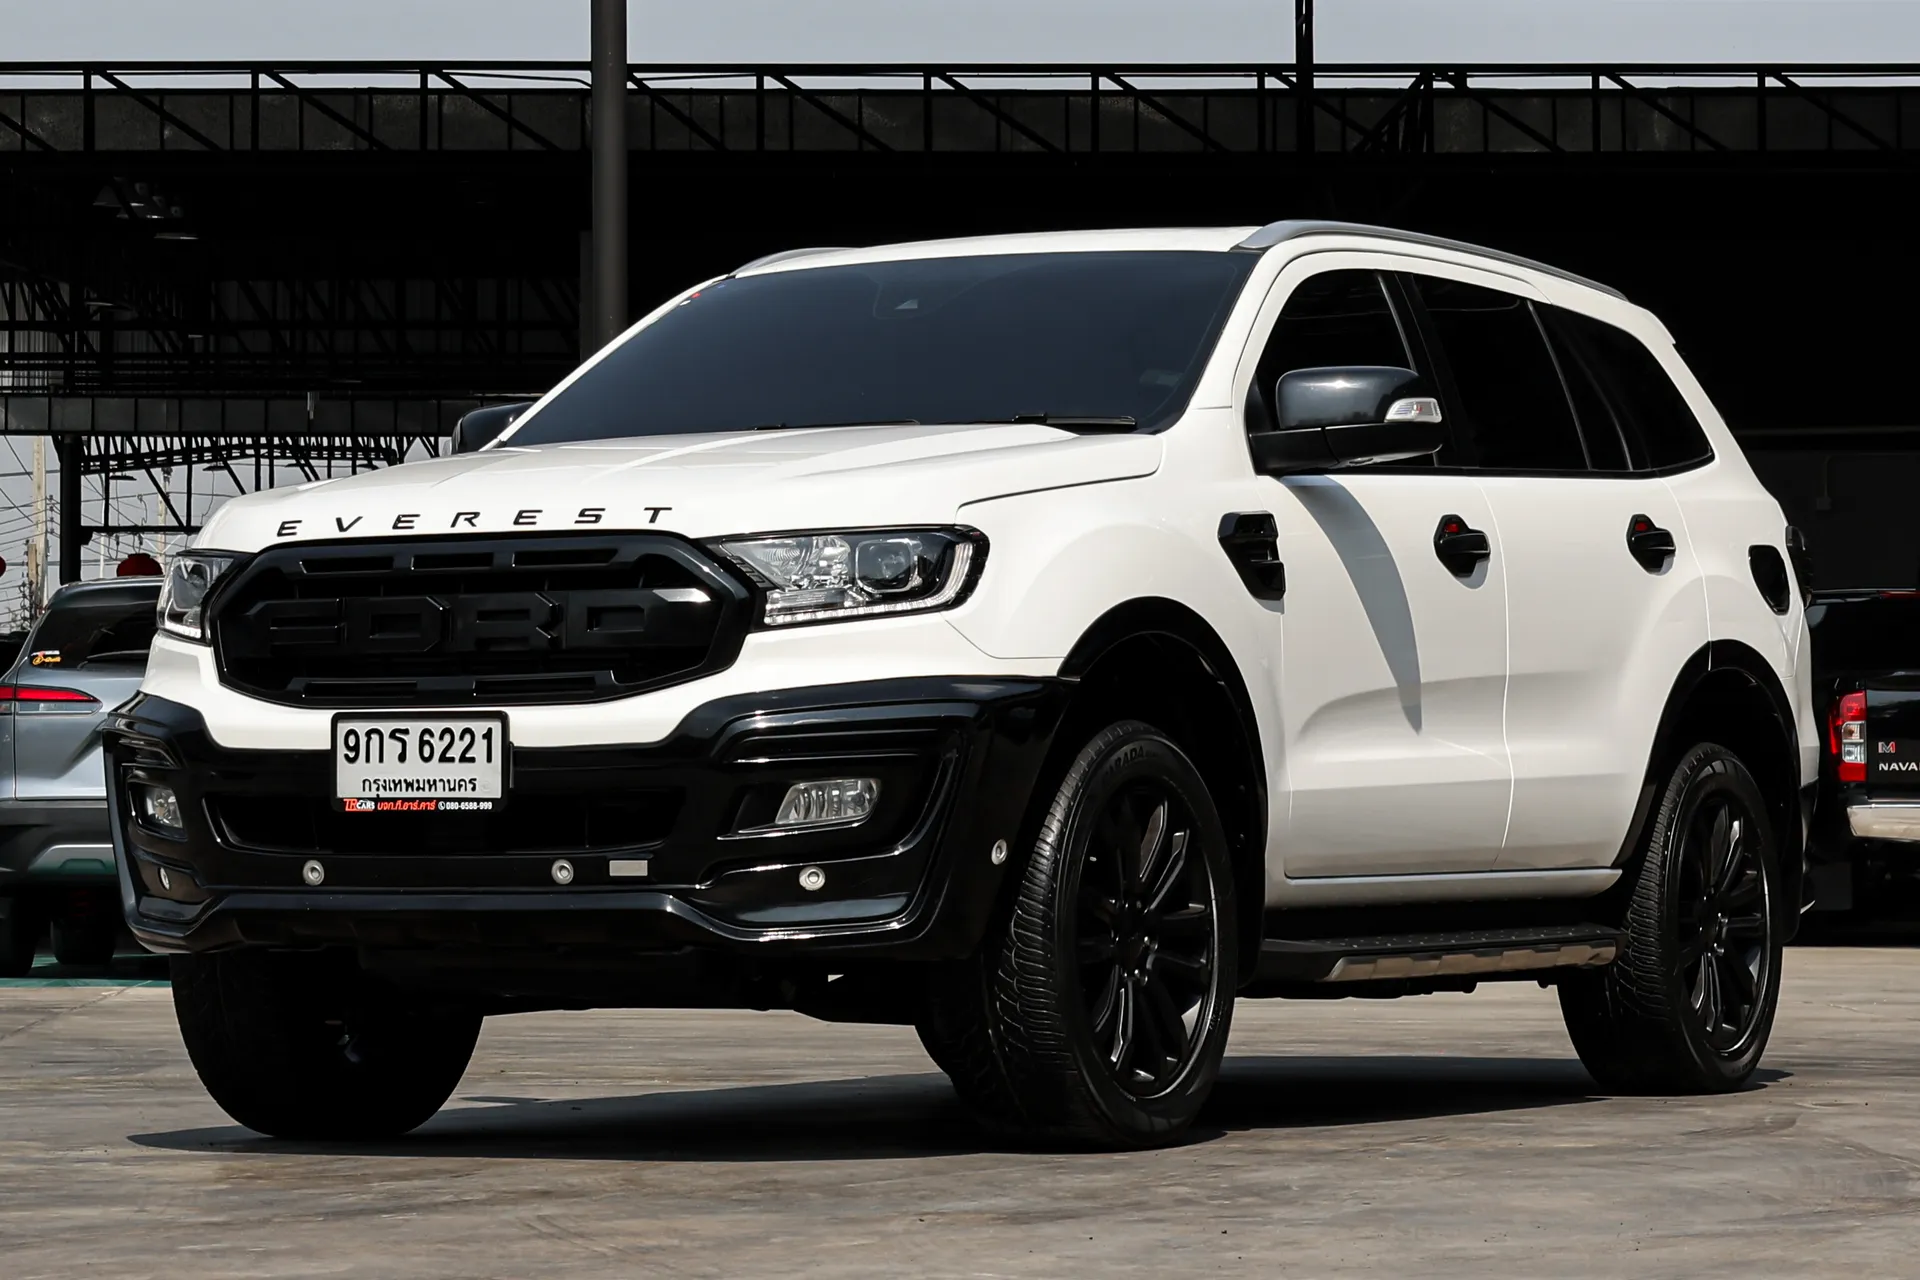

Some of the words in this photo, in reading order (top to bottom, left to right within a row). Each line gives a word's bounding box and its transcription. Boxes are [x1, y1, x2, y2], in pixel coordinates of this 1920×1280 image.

[276, 506, 673, 538] EVEREST
[260, 590, 672, 653] FORD
[343, 726, 410, 764] 9กร
[418, 726, 493, 764] 6221
[1879, 761, 1920, 771] NAVA
[361, 777, 477, 798] กรุงเทพมหานคร
